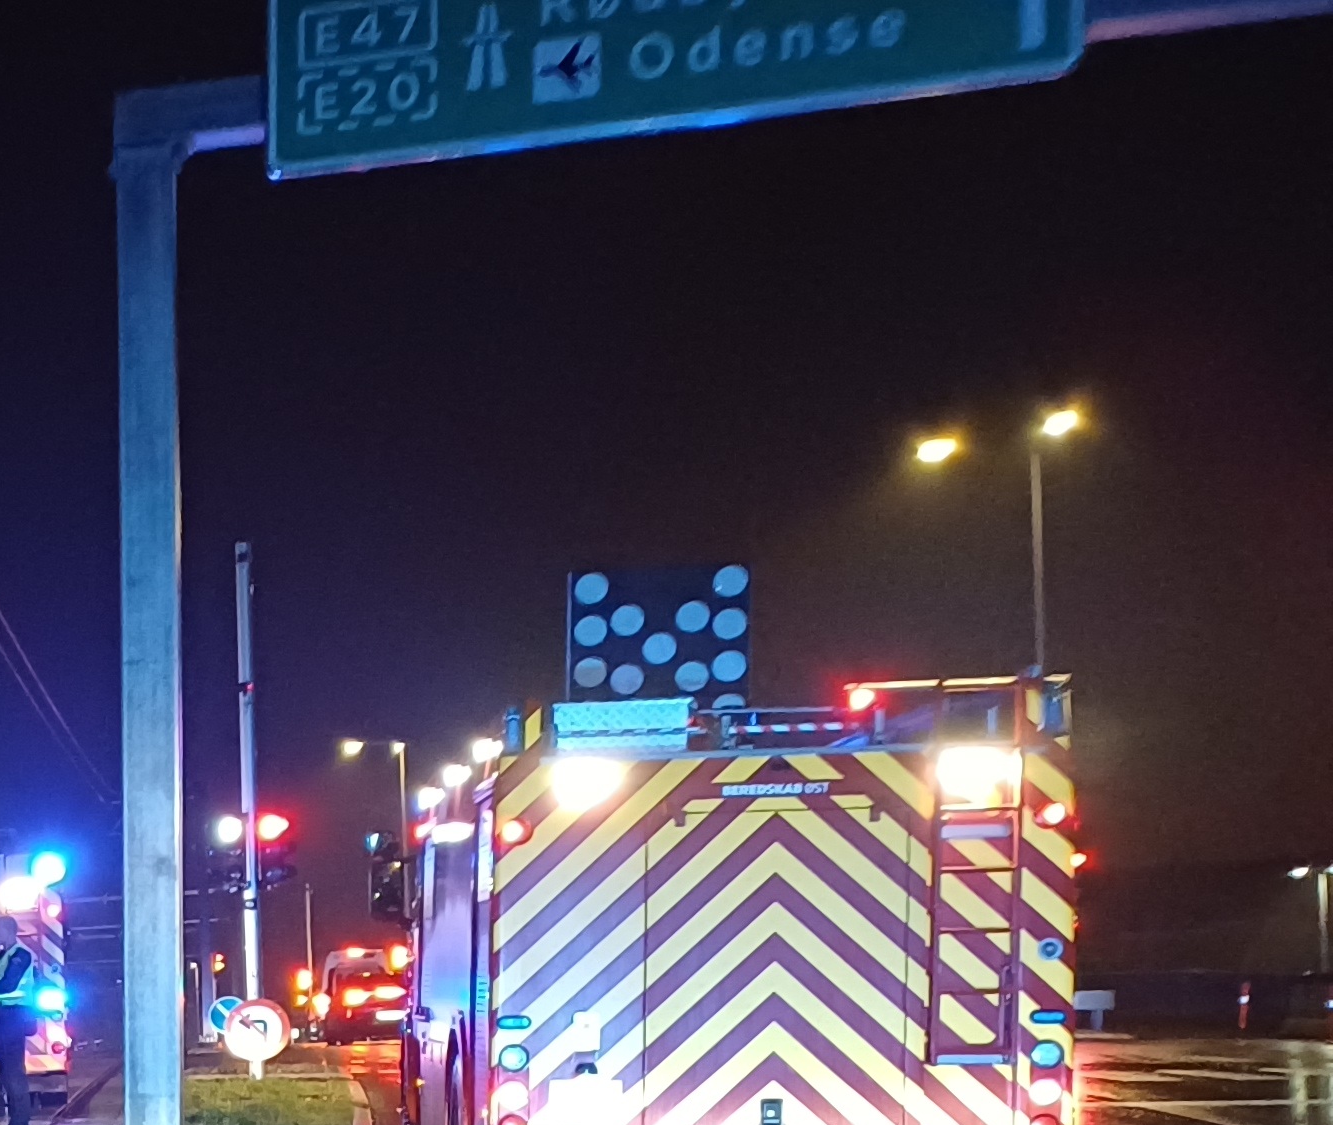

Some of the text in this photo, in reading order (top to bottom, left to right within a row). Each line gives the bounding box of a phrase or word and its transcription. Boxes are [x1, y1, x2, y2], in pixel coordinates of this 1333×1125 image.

[315, 6, 419, 54] E47
[629, 9, 906, 80] Odense
[315, 71, 420, 119] E20
